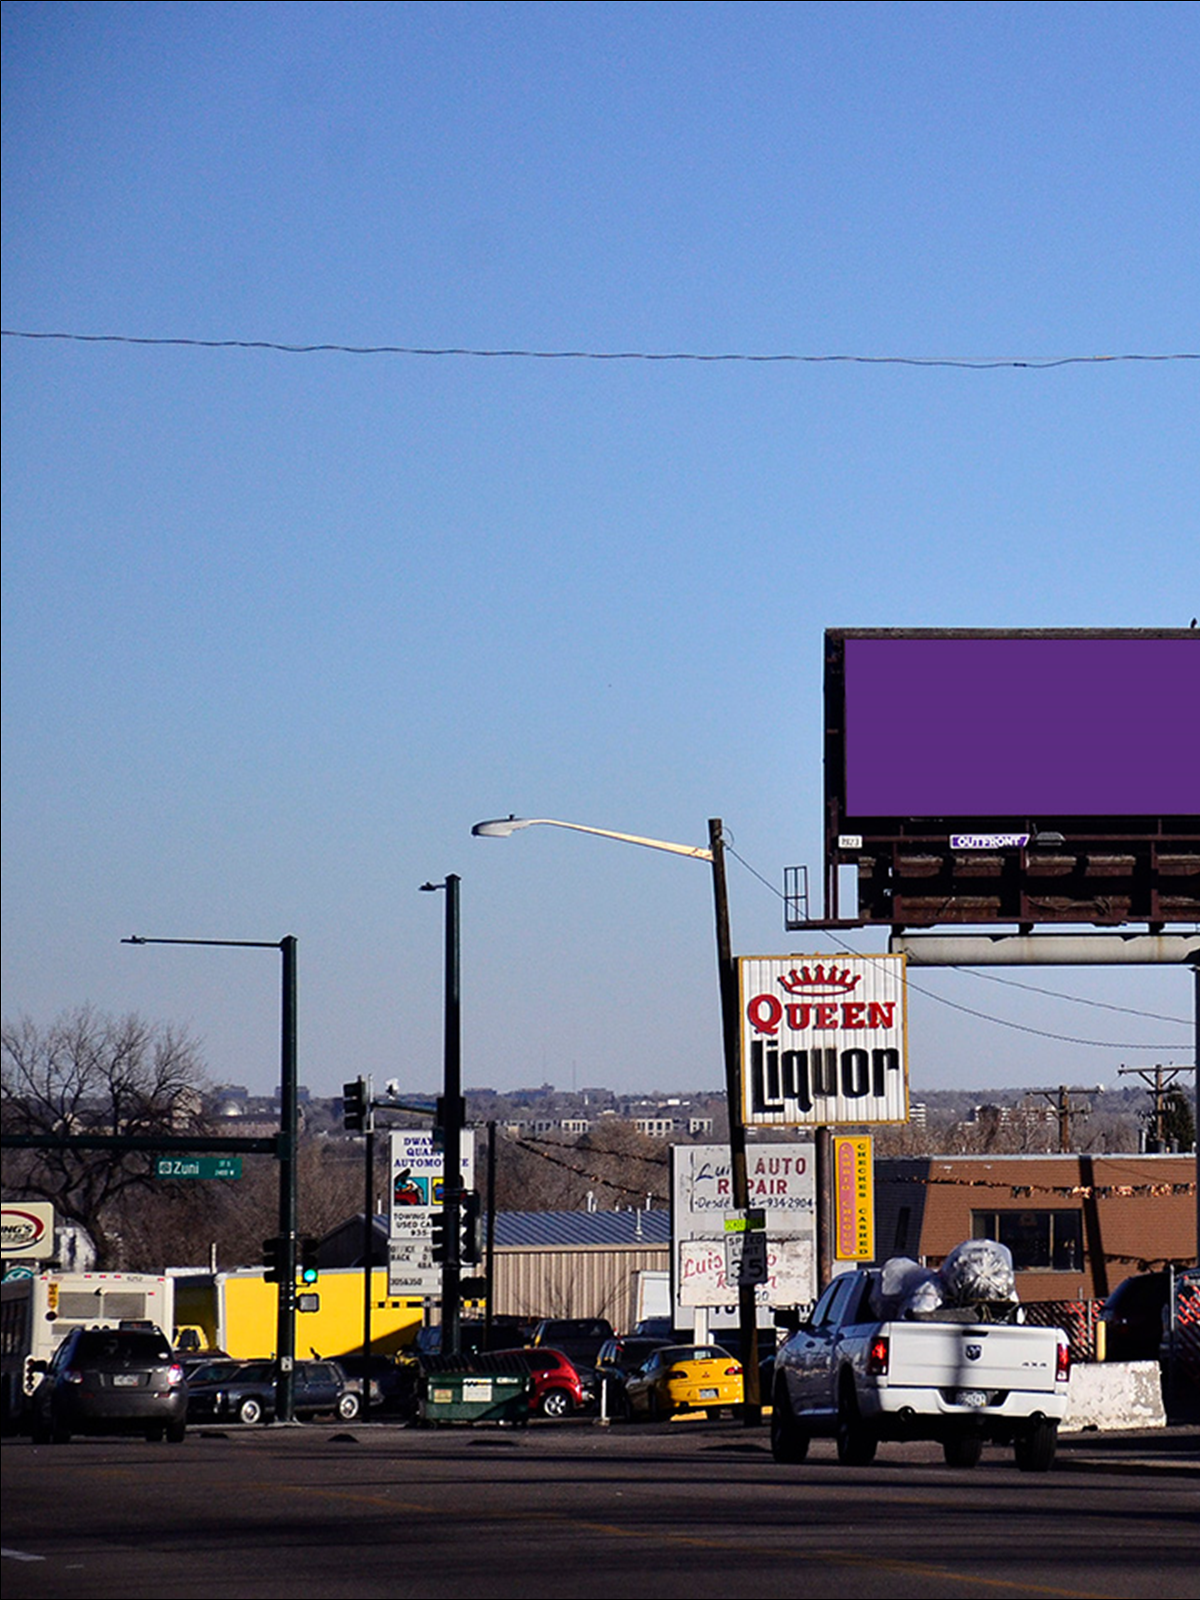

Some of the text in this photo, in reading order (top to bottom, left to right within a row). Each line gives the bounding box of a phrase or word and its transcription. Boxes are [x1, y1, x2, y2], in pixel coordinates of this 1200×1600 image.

[956, 837, 1020, 847] OUTFRONT
[751, 1040, 900, 1114] Liquor
[173, 1161, 200, 1175] Zuni
[394, 1158, 470, 1168] AUTOMOE
[695, 1157, 807, 1182] Lui AUTO
[717, 1178, 788, 1195] RPAIR
[730, 1259, 764, 1279] 35
